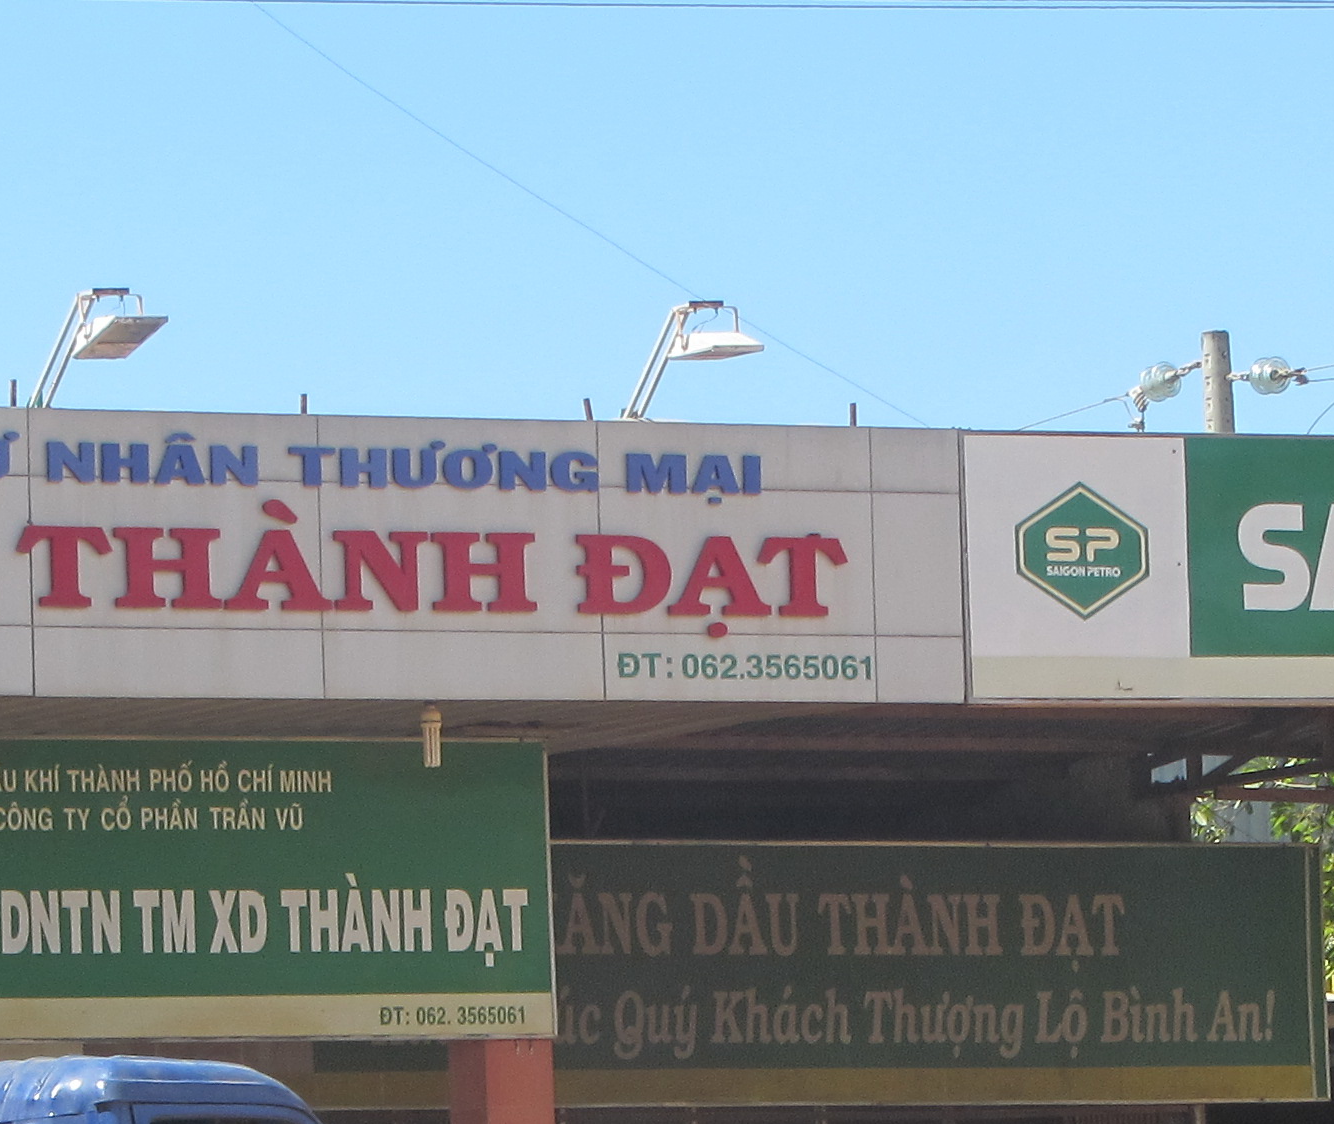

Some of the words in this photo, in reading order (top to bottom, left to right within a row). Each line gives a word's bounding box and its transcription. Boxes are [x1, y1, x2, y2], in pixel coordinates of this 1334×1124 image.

[46, 432, 259, 487] NHÂN
[288, 439, 600, 493] THƯƠNG
[626, 452, 762, 505] MẠI
[1045, 527, 1121, 562] SP
[17, 499, 538, 613] THÀNH
[575, 533, 849, 638] ĐẠT
[1046, 565, 1086, 577] SAIGON
[1087, 565, 1121, 577] PETRO
[617, 654, 674, 680] ĐT:
[681, 654, 874, 682] 062.3565061
[25, 764, 60, 792] KHÍ
[67, 763, 141, 792] THÀNH
[149, 761, 193, 793] PHỐ
[200, 760, 231, 794] HỒ
[237, 765, 273, 793] CHÍ
[279, 770, 332, 793] MINH
[63, 808, 91, 831] TY
[100, 795, 132, 831] CỔ
[141, 799, 199, 831] PHẦN
[209, 799, 268, 832] TRẦN
[274, 805, 304, 832] VŨ
[2, 889, 121, 954] DNTN
[133, 889, 197, 954] TM
[209, 889, 269, 954] XD
[280, 874, 433, 952] THÀNH
[444, 889, 528, 967] ĐẠT
[555, 872, 673, 957] ĂNG
[691, 856, 800, 957] DẦU
[817, 875, 1005, 957] THÀNH
[1021, 893, 1126, 973] ĐẠT
[379, 1005, 411, 1025] ĐT:
[456, 1005, 527, 1025] 3565061
[613, 990, 700, 1060] Quý
[711, 985, 852, 1046] Khách
[864, 990, 1023, 1060] Thượng
[1036, 987, 1089, 1060] Lộ
[1102, 988, 1198, 1045] Bình
[1207, 990, 1277, 1042] An!
